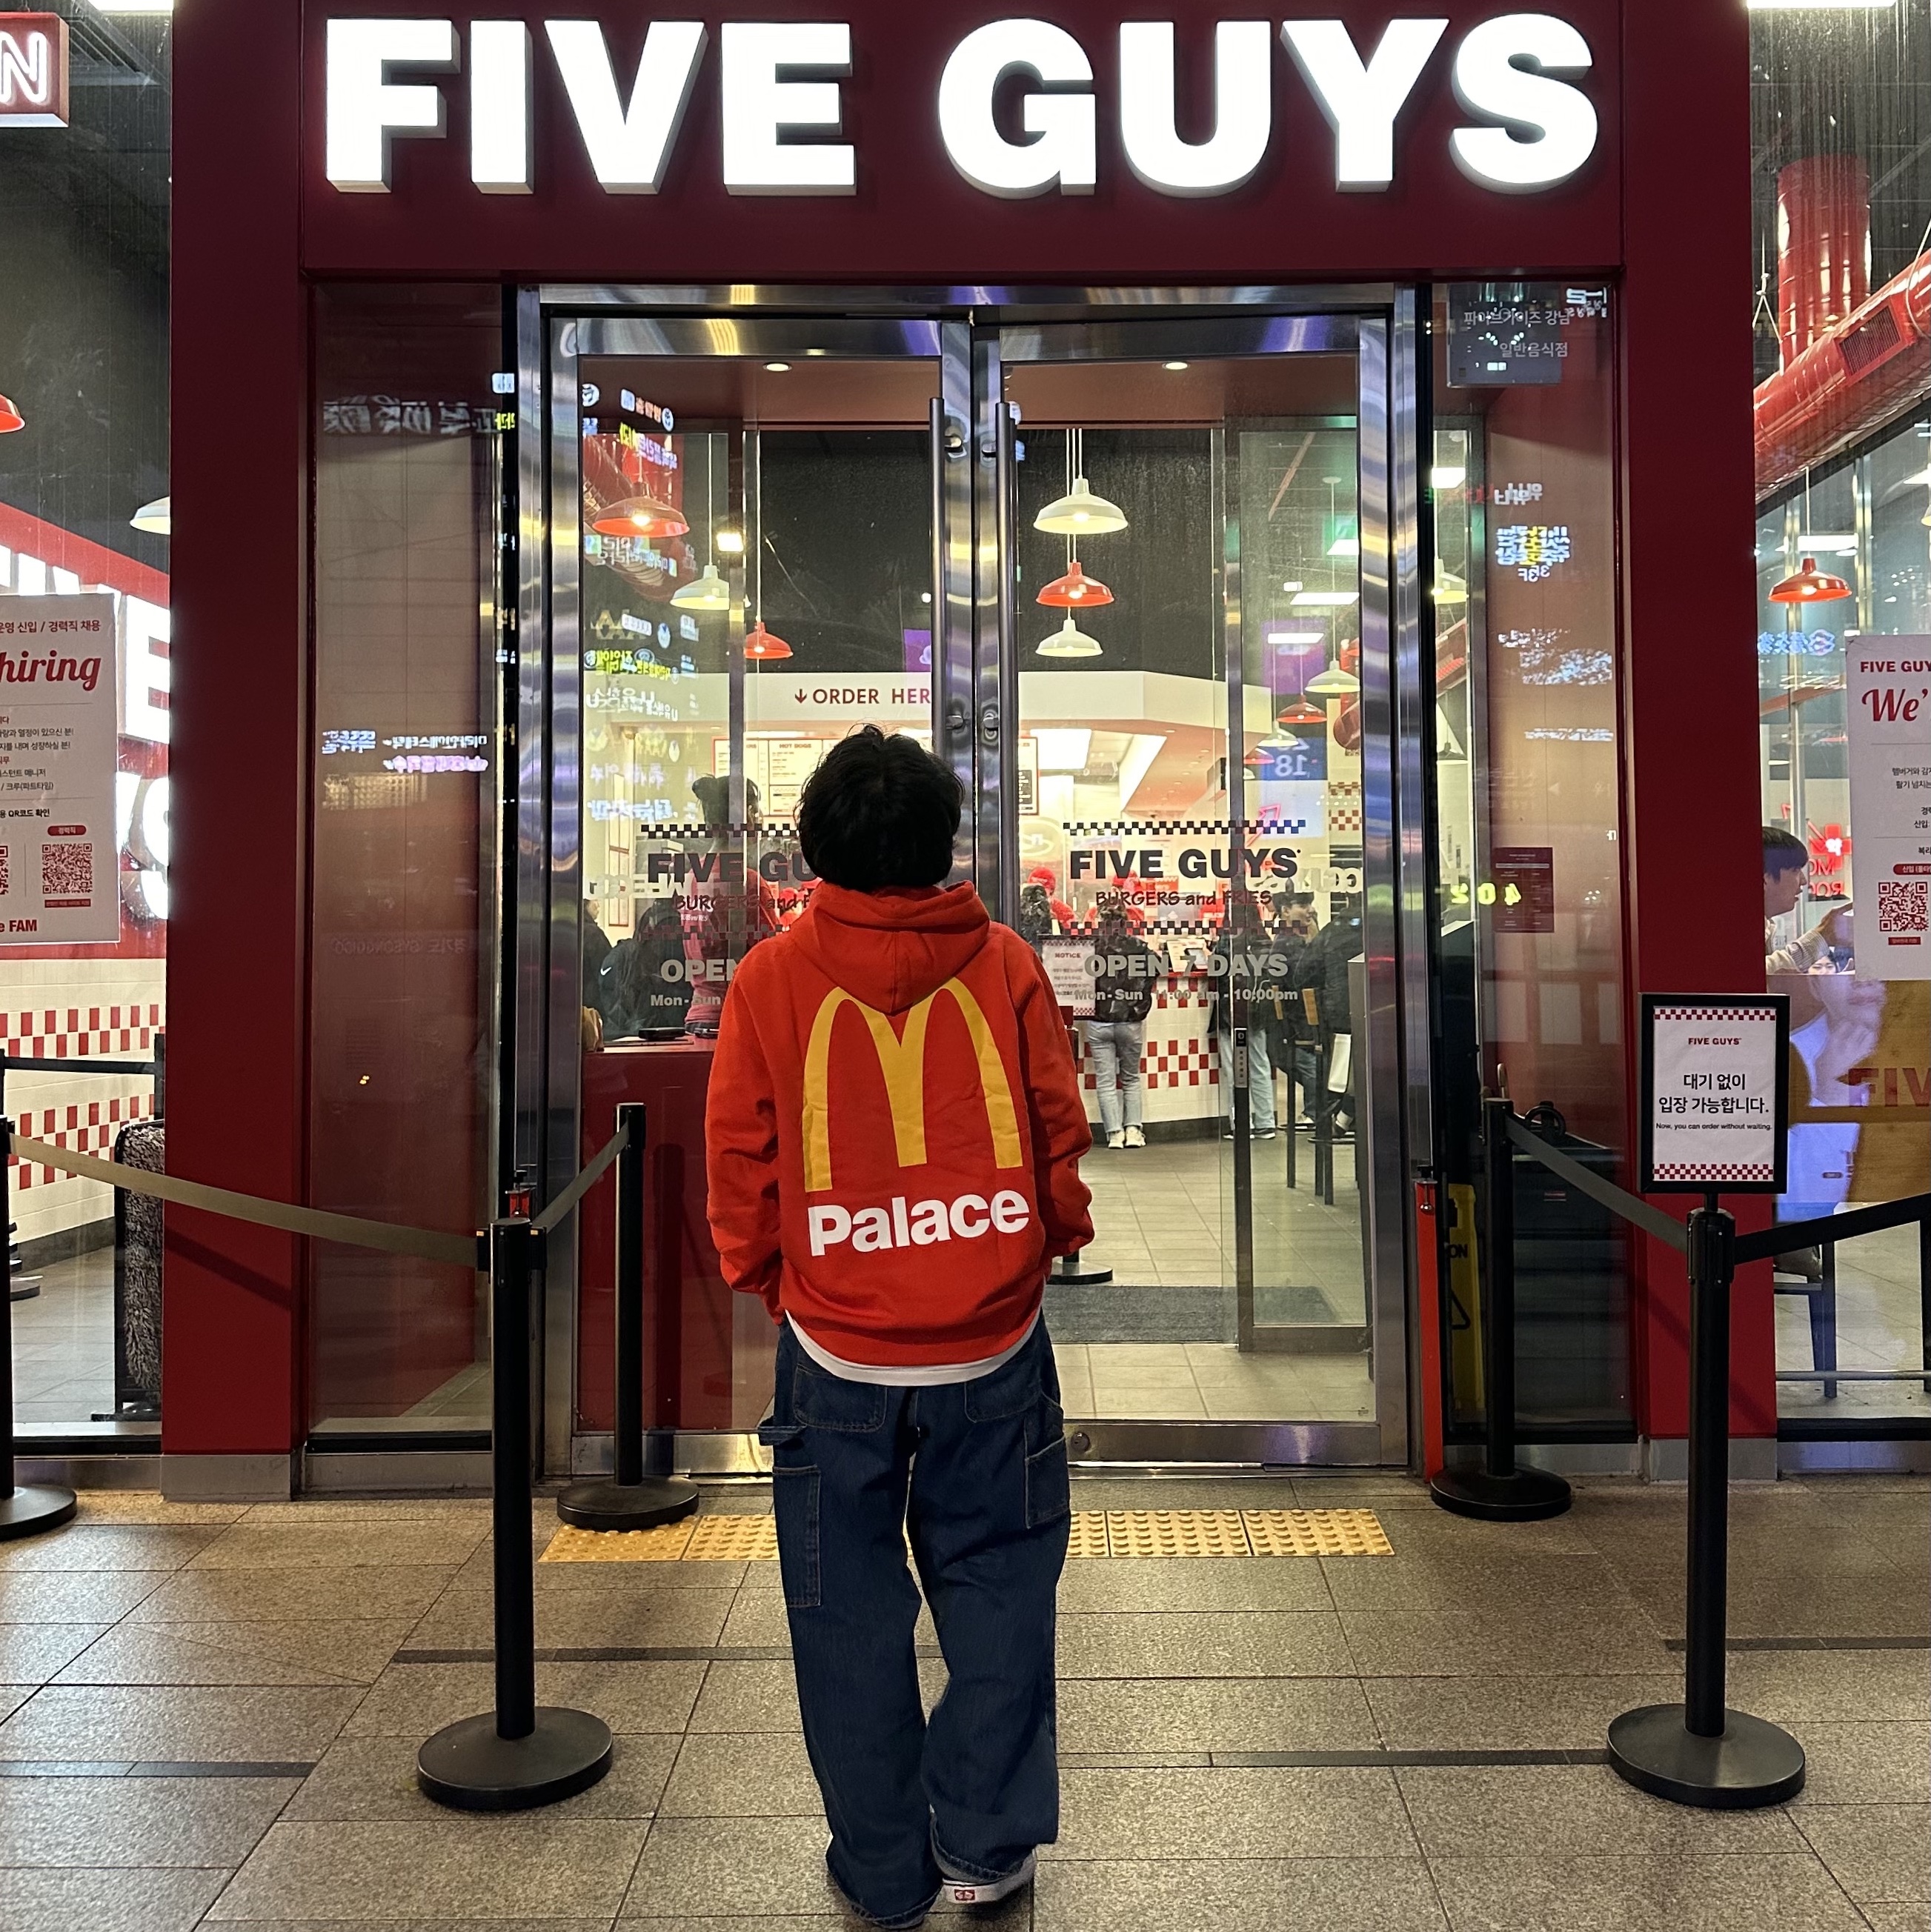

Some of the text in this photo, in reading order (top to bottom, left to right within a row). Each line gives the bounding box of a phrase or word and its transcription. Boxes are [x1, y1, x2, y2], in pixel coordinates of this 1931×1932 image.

[326, 13, 1598, 199] FIVE GUYS
[1545, 310, 1571, 325] 강남
[1500, 342, 1568, 358] 일반음식점
[18, 622, 37, 633] 신입
[48, 621, 78, 632] 경력직
[80, 620, 101, 632] 채용
[0, 650, 102, 691] hiring
[1861, 662, 1895, 673] FIVE
[813, 689, 880, 704] ORDER
[19, 728, 40, 737] 열정이
[41, 727, 62, 736] 있으신
[31, 742, 59, 750] 성장하실
[24, 769, 46, 777] 매니저
[36, 808, 50, 817] 확인
[648, 853, 743, 883] FIVE
[1070, 848, 1301, 879] FIVE GUYS
[1096, 890, 1272, 905] BURGERS and FRIES
[9, 919, 37, 932] FAM
[1084, 954, 1289, 977] OPEN 7 DAYS
[1684, 1073, 1746, 1090] 대기 없이
[1659, 1096, 1769, 1114] 입장 가능합니다.
[1746, 1123, 1772, 1131] waiting.
[808, 1190, 1030, 1257] Palace
